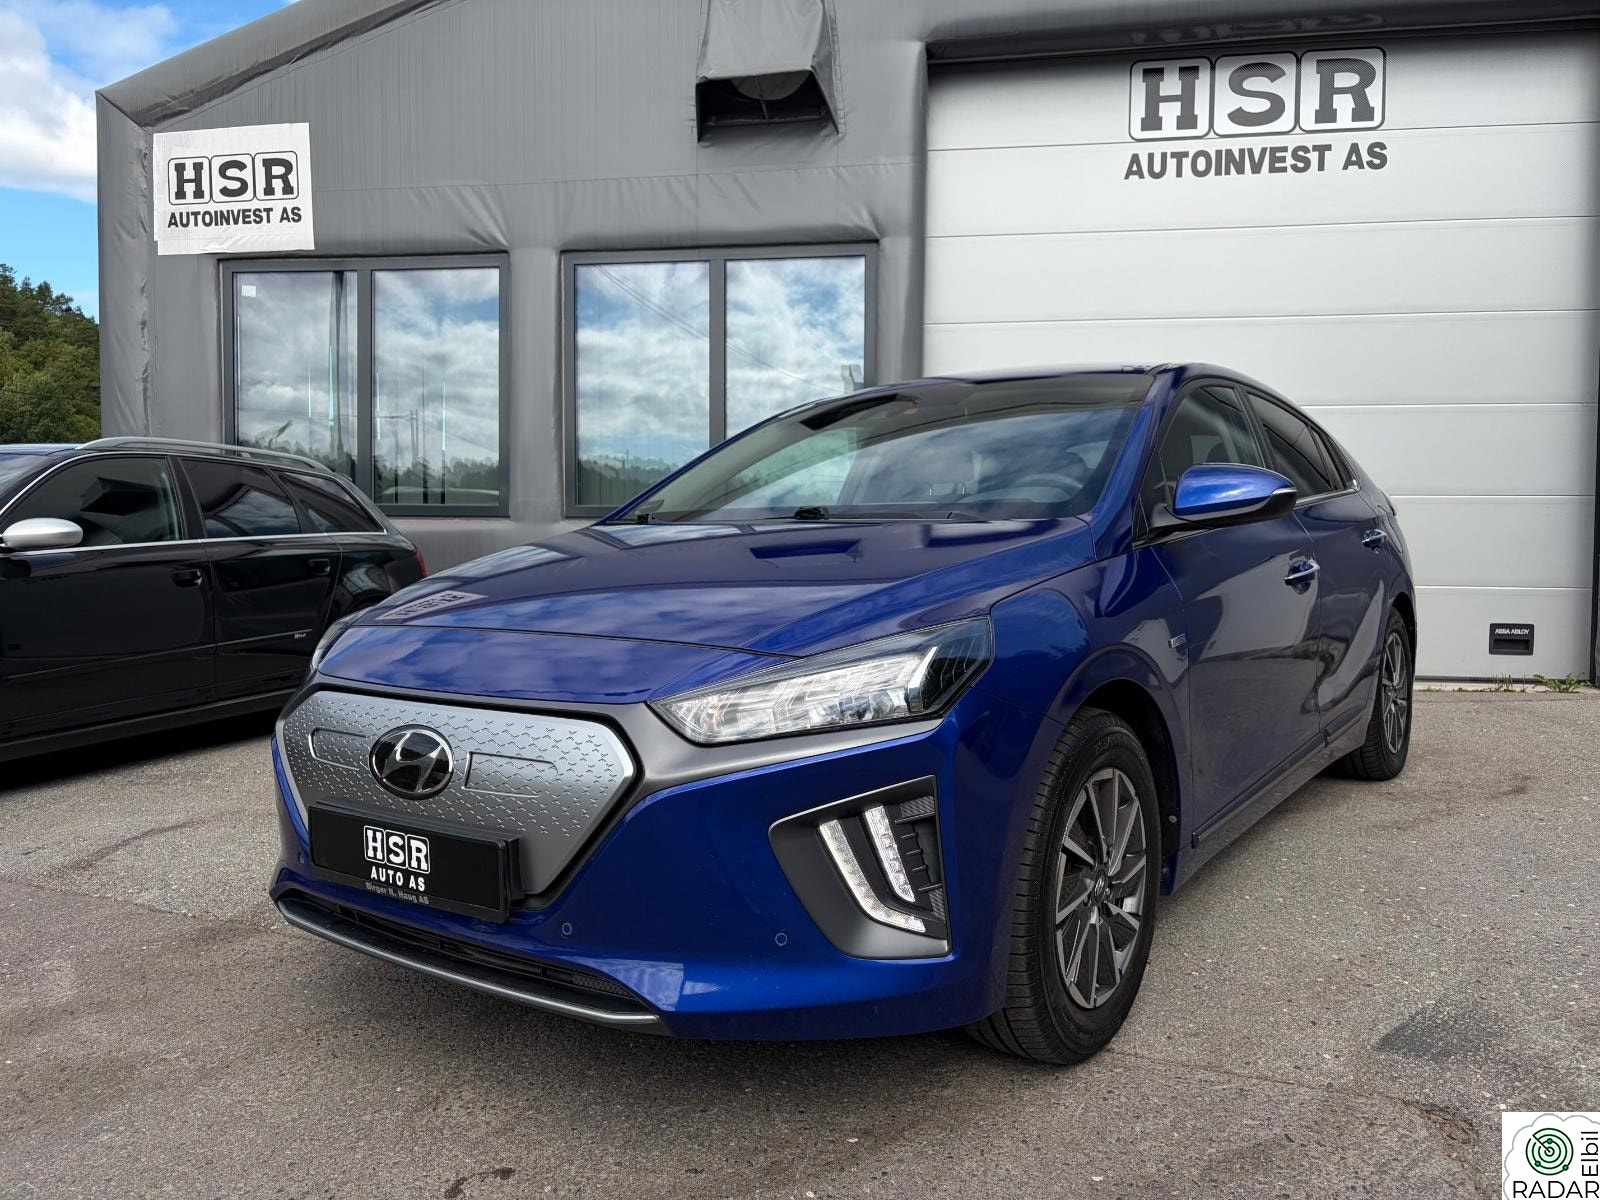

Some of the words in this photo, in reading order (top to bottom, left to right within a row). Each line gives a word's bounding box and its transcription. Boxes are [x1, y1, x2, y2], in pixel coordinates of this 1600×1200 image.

[1140, 57, 1377, 132] HSR
[174, 157, 295, 201] HSR
[1124, 143, 1332, 180] AUTOINVEST
[1342, 141, 1388, 171] AS
[167, 207, 273, 228] AUTOINVEST
[279, 206, 302, 223] AS
[366, 829, 428, 871] HSR
[365, 881, 387, 894] Birger
[419, 895, 430, 905] AS
[370, 865, 404, 886] AUTO
[409, 875, 426, 892] AS
